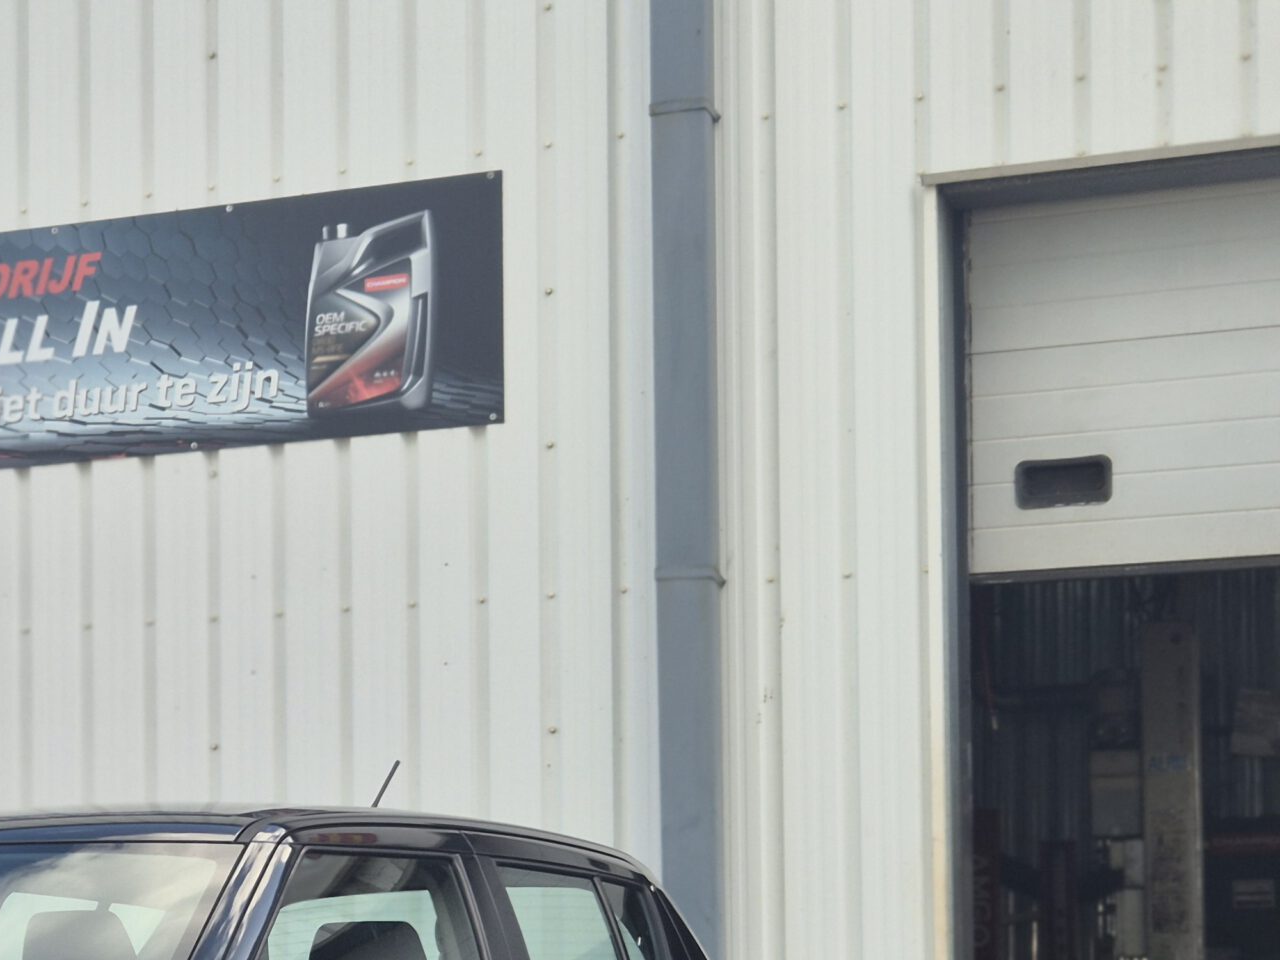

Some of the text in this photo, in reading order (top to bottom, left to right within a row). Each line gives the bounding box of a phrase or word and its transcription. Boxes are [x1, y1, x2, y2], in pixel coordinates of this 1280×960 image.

[71, 301, 138, 356] IN
[314, 320, 368, 336] SPECIFIC
[316, 311, 345, 325] OEM
[52, 380, 147, 420] duur
[156, 370, 196, 408] te
[207, 362, 280, 412] zijn
